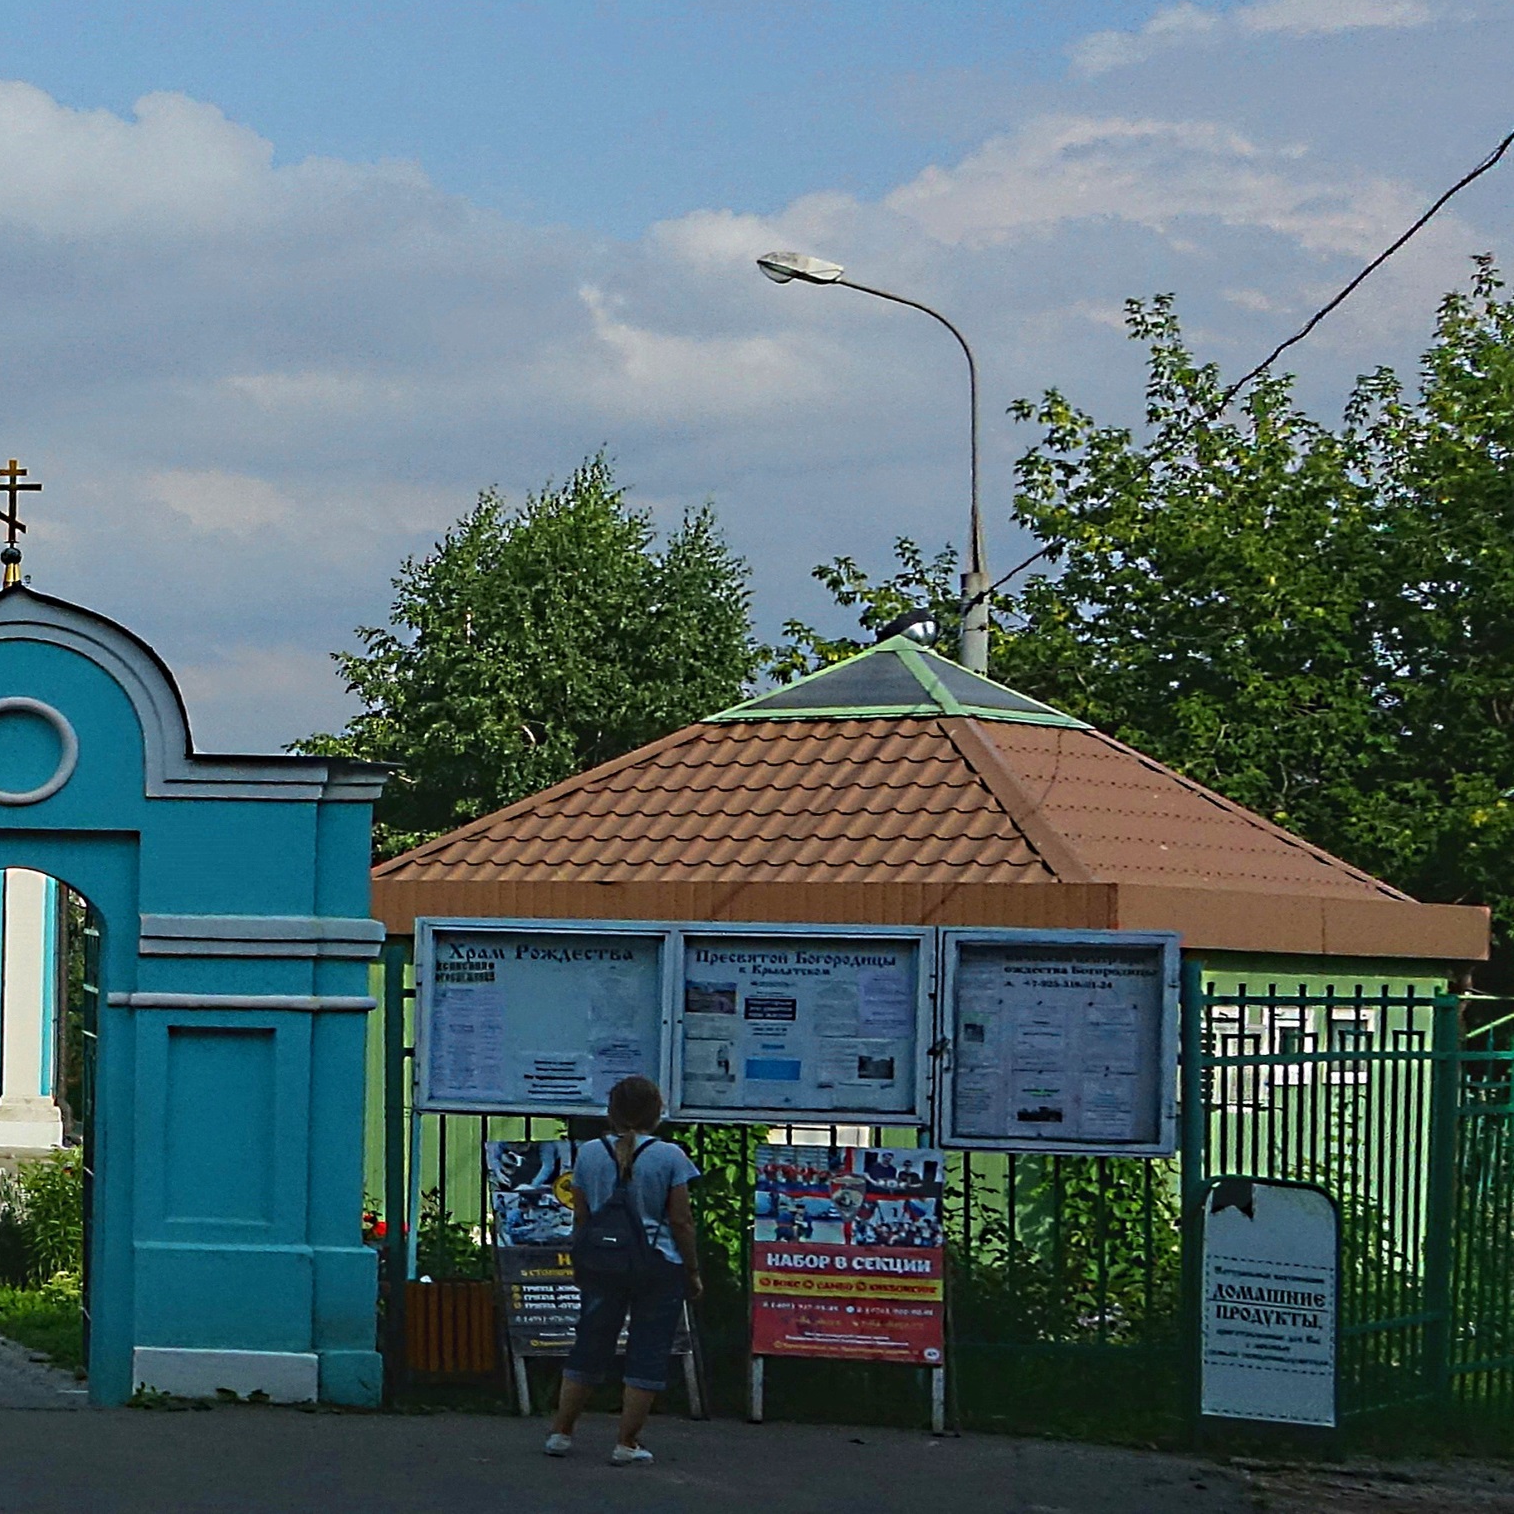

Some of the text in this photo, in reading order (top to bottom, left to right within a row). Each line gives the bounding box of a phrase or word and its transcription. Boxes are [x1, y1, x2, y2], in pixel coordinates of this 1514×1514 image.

[449, 943, 634, 962] Храм Рождества
[696, 950, 896, 968] Пресвятой Богородицы
[752, 965, 830, 976] Крылатском
[767, 1253, 931, 1274] НАБОР В СЕКЦИИ
[1213, 1284, 1326, 1308] ДОМАШНИЕ
